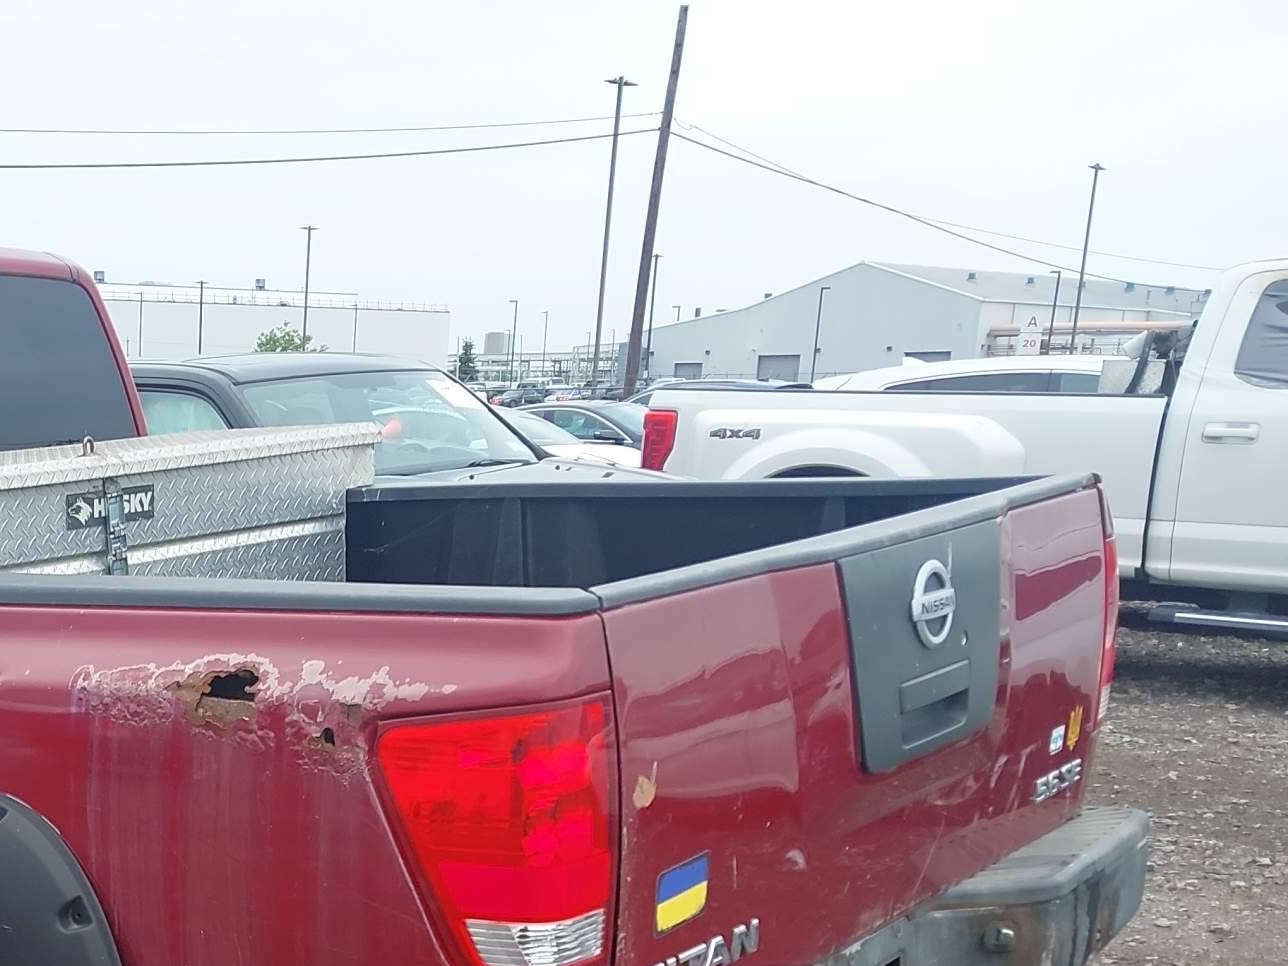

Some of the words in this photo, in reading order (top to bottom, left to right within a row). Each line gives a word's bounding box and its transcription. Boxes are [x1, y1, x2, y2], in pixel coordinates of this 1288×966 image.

[1027, 316, 1038, 328] A
[1022, 339, 1037, 348] 20
[93, 491, 153, 518] HSKY
[921, 593, 953, 616] NISSAN
